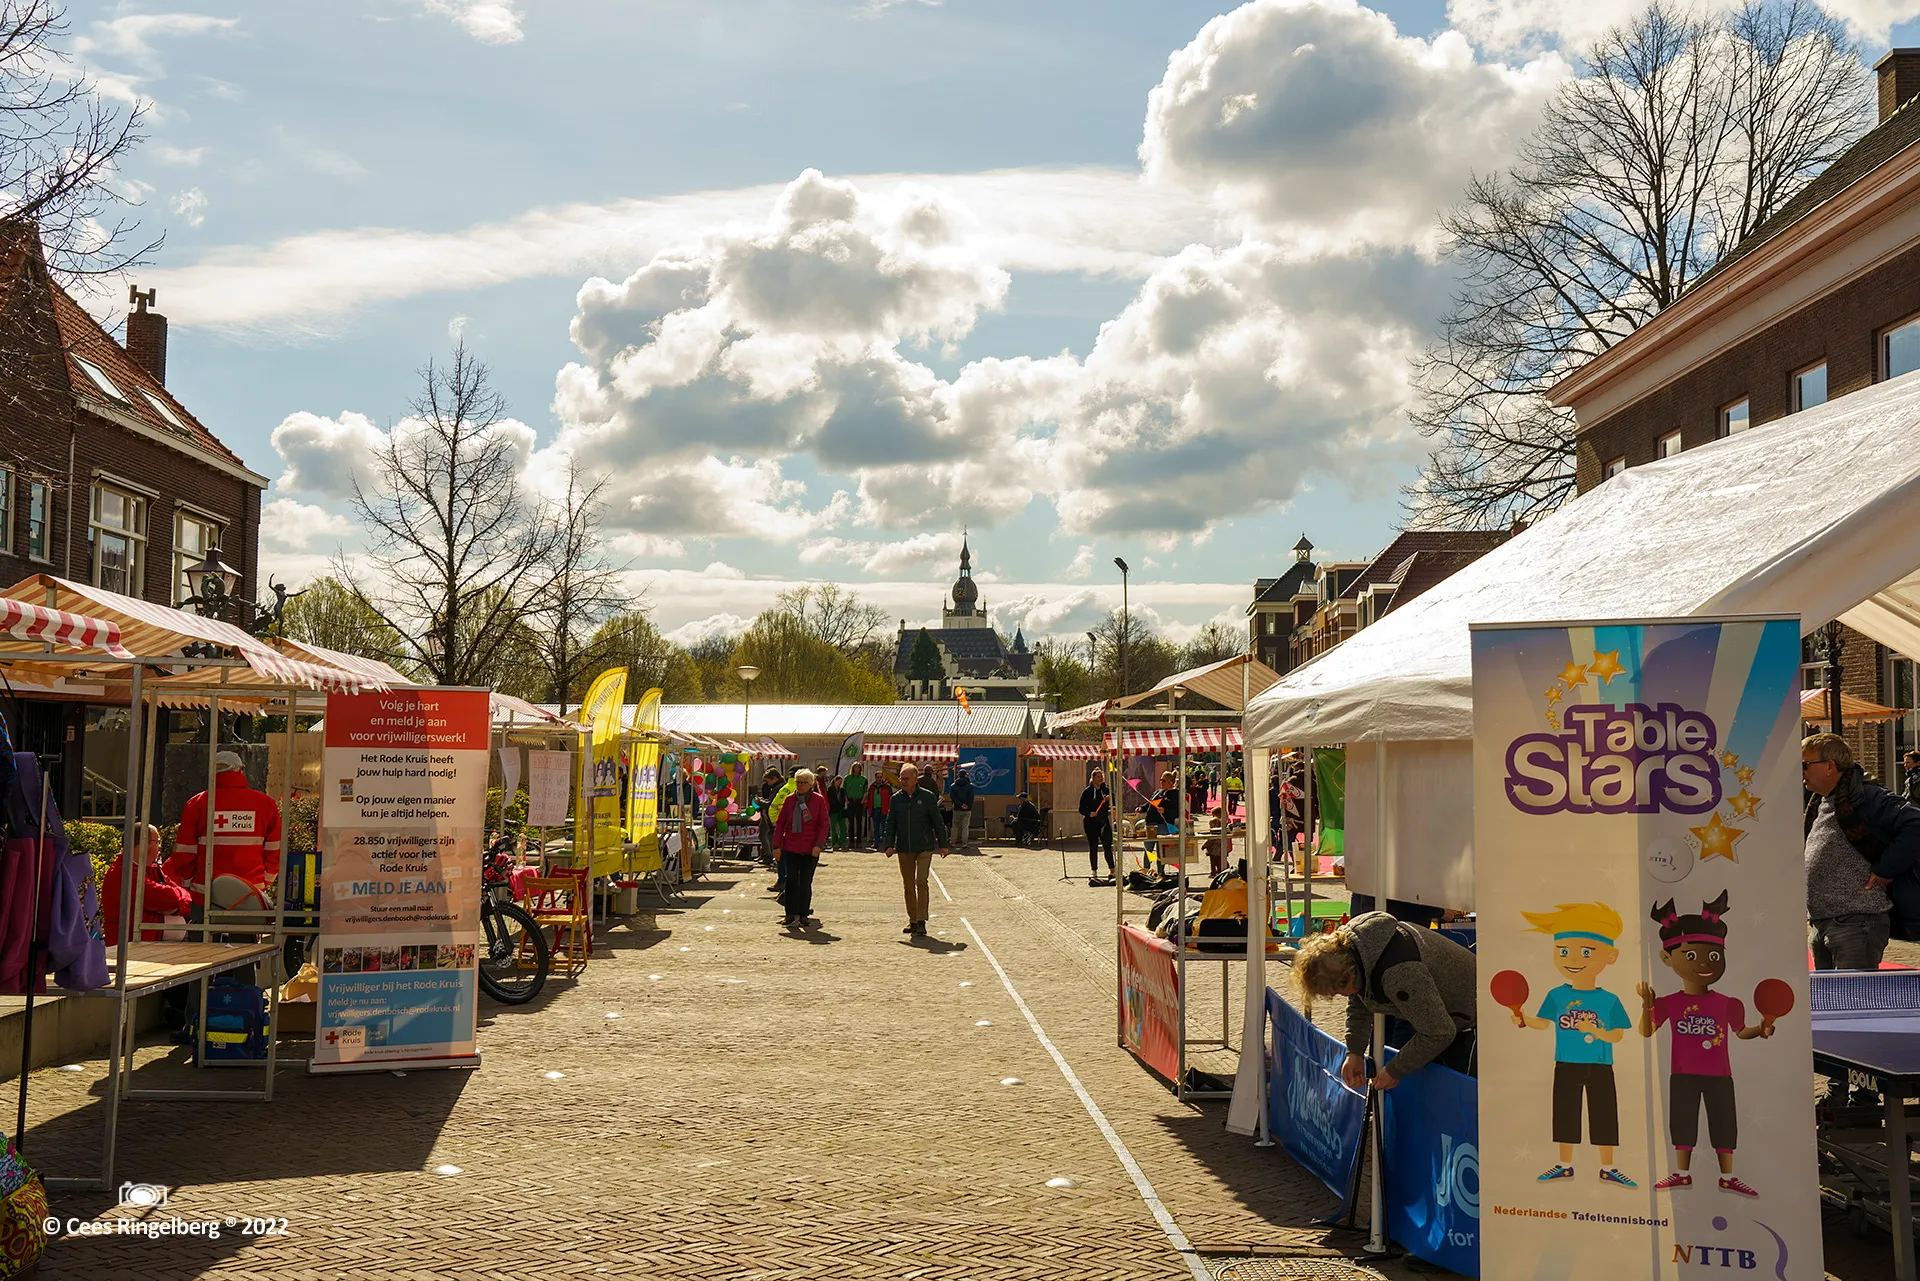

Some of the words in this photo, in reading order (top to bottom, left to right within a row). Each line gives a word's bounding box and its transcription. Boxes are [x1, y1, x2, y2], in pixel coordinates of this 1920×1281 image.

[379, 700, 403, 711] Volg
[405, 700, 415, 711] je
[417, 700, 440, 711] hart
[370, 718, 384, 726] en
[386, 716, 413, 726] meld
[415, 717, 425, 728] je
[427, 719, 447, 727] aan
[350, 732, 375, 741] voor
[376, 731, 466, 743] vrijwilligerswerk!
[1572, 710, 1708, 752] Table
[360, 754, 377, 763] Het
[379, 754, 404, 763] Rode
[405, 754, 428, 763] Kruis
[430, 754, 454, 764] heeft
[356, 768, 381, 778] jouw
[382, 767, 403, 778] hulp
[405, 768, 426, 777] hard
[428, 768, 457, 779] nodig!
[1511, 741, 1714, 807] Stars
[356, 795, 370, 805] Op
[371, 795, 395, 806] jouw
[397, 795, 422, 806] eigen
[423, 795, 456, 805] manier
[361, 809, 379, 818] kun
[380, 809, 390, 820] je
[390, 809, 414, 820] altijd
[415, 809, 450, 820] helpen.
[353, 836, 385, 845] 28.850
[387, 836, 438, 847] vrijwilligers
[439, 837, 455, 847] zijn
[371, 850, 398, 859] actief
[399, 851, 420, 859] voor
[421, 850, 437, 859] het
[379, 864, 404, 873] Rode
[405, 864, 428, 873] Kruis
[352, 882, 395, 895] MELD
[398, 881, 414, 894] JE
[370, 905, 388, 913] Stuur
[345, 914, 459, 924] vrijwilligers.denbosch@rodekruis.nl
[329, 982, 381, 994] Vrijwilliger
[382, 982, 395, 993] bij
[396, 981, 411, 991] het
[413, 980, 437, 989] Rode
[439, 979, 463, 989] Kruis
[328, 999, 349, 1007] Meld
[350, 998, 358, 1008] je
[327, 1004, 461, 1019] vrijwilligers.denbosch@rodekruis.nl
[1688, 1015, 1715, 1025] Table
[342, 1029, 362, 1037] Rode
[1677, 1021, 1716, 1035] Stars
[1848, 1068, 1878, 1092] JOOLA
[1494, 1206, 1568, 1220] Nederlandse
[1572, 1211, 1669, 1227] Tafeltennisbond
[1447, 1228, 1475, 1246] for
[1672, 1244, 1757, 1270] NTTB
